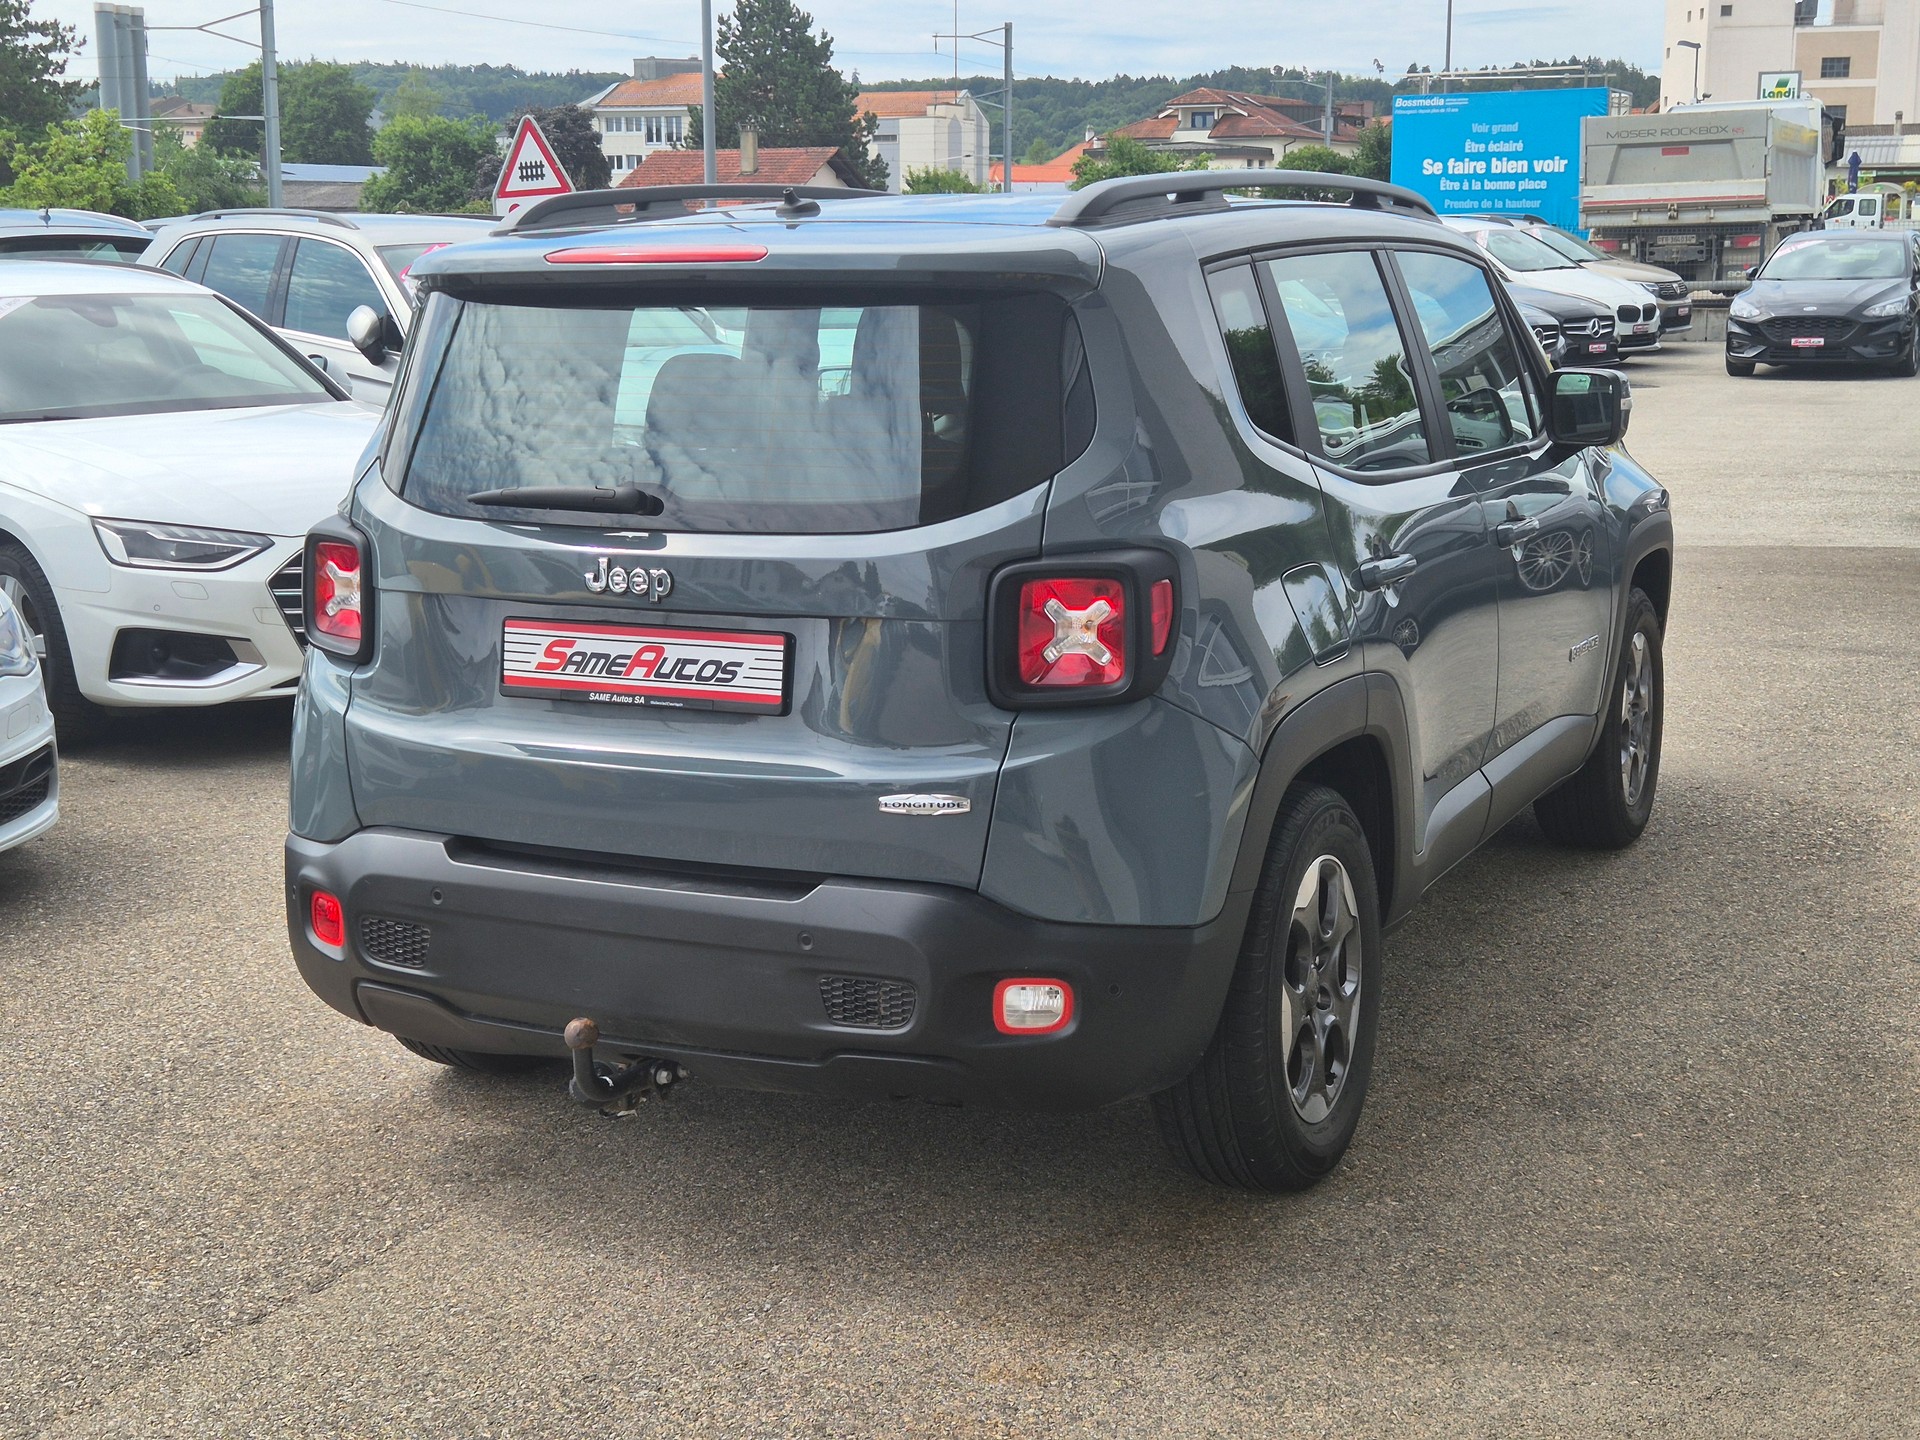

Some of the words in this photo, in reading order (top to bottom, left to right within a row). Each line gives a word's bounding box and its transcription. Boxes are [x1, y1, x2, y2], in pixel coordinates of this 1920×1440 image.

[1762, 88, 1796, 99] Landi
[1395, 97, 1445, 107] Bossmedia
[1471, 123, 1490, 133] Voir
[1491, 122, 1519, 135] grand
[1606, 129, 1657, 139] MOSER
[1660, 125, 1729, 137] ROCKBOX
[1465, 139, 1486, 152] Être
[1487, 140, 1524, 152] éclairé
[1422, 159, 1443, 175] Se
[1447, 158, 1487, 174] faire
[1491, 157, 1528, 174] bien
[1533, 156, 1568, 173] voir
[1440, 177, 1460, 191] Être
[1462, 179, 1469, 191] à
[1471, 179, 1481, 190] la
[1484, 179, 1516, 190] bonne
[1518, 178, 1548, 192] place
[1444, 199, 1479, 209] Prendre
[1481, 199, 1493, 208] de
[1494, 199, 1503, 208] la
[1505, 199, 1542, 208] hauteur
[584, 557, 675, 603] Jeep
[589, 692, 611, 702] SAME
[611, 694, 633, 704] Autos
[634, 696, 645, 704] SA
[883, 801, 965, 809] LONGITUDE
